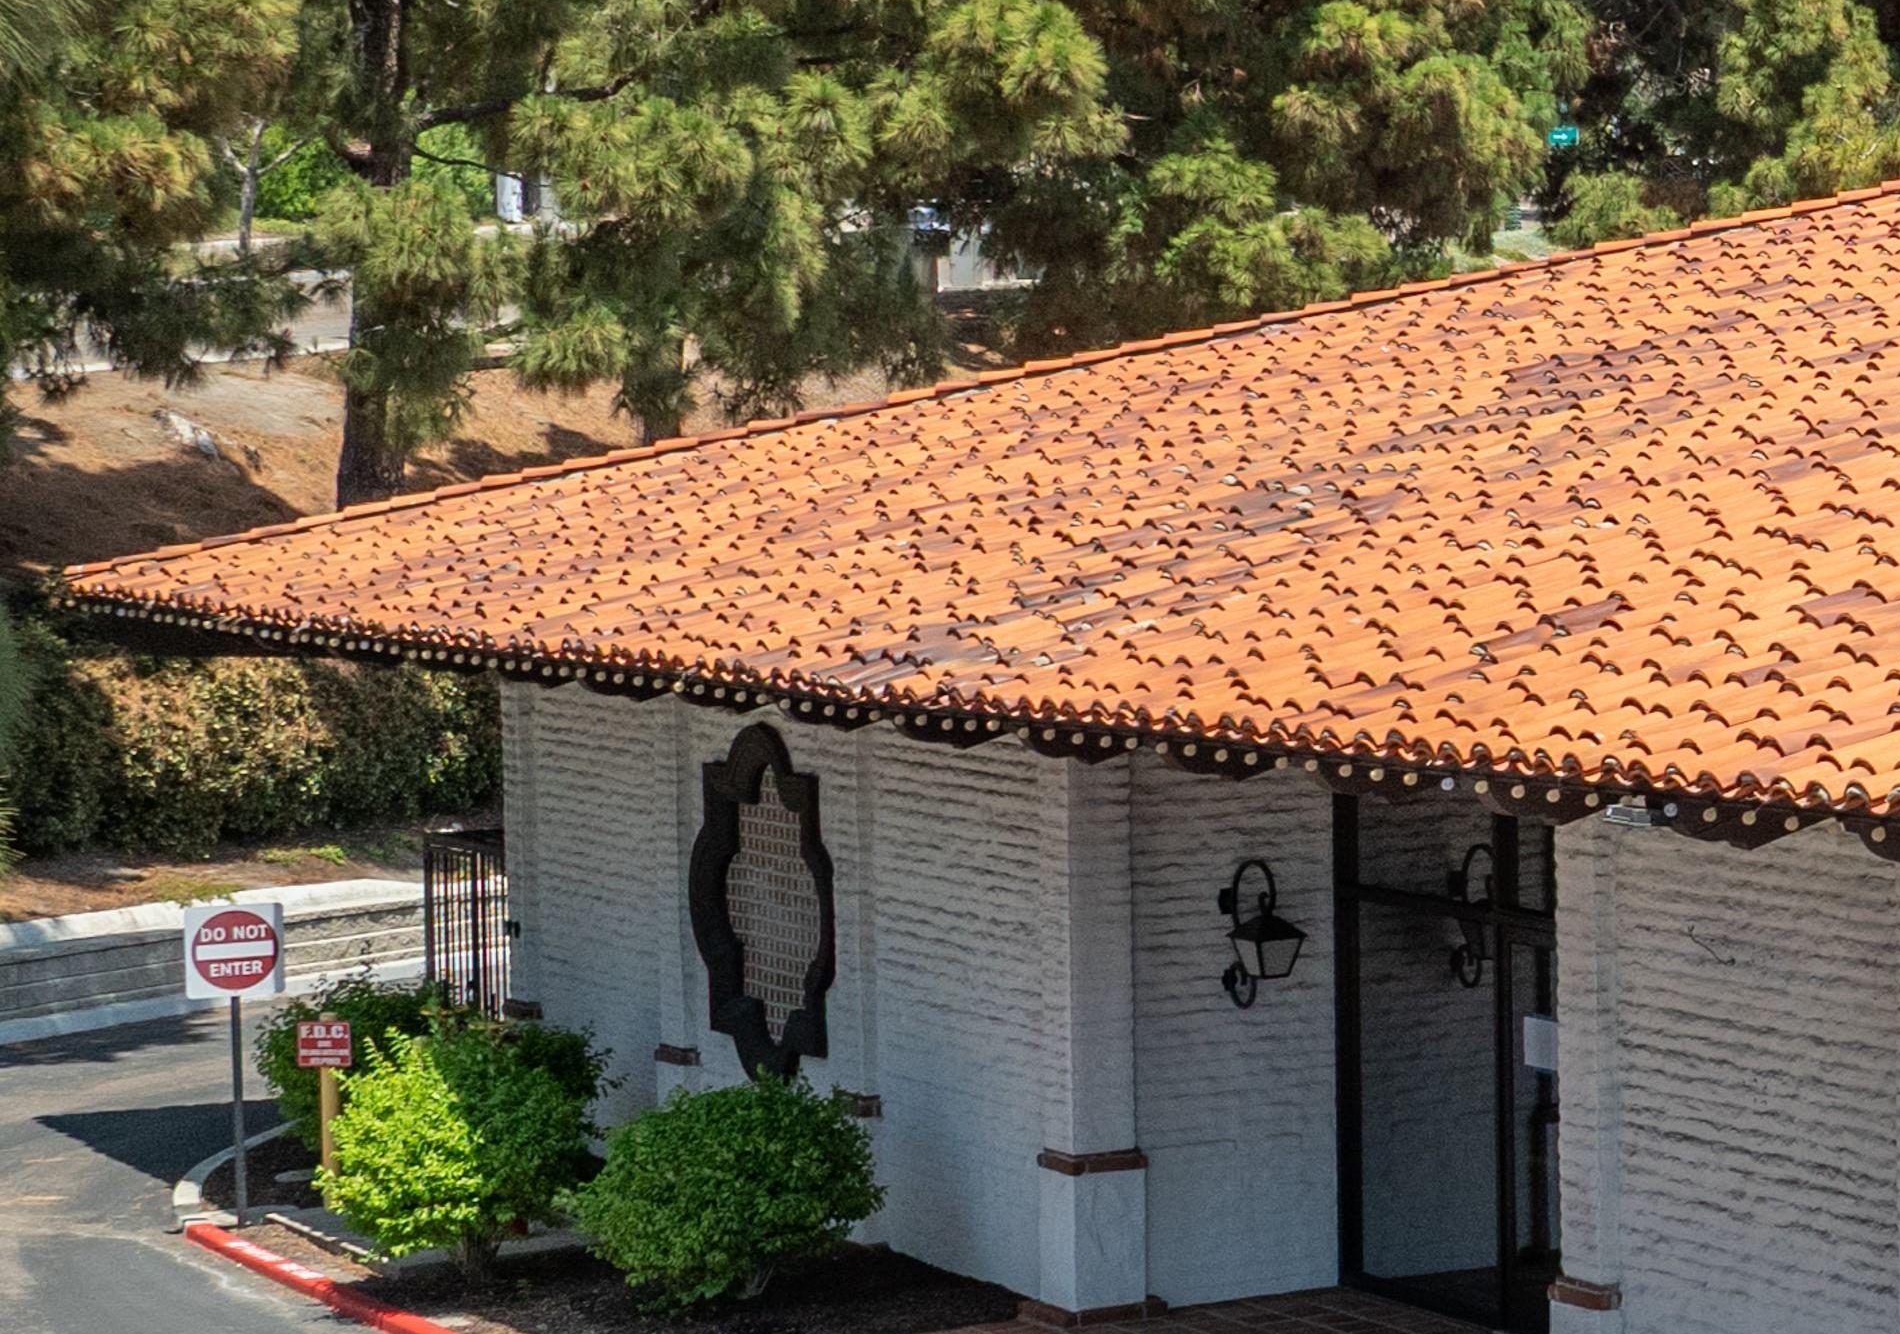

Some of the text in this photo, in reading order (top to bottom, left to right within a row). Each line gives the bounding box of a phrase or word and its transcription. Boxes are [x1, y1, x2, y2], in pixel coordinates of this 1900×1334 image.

[200, 924, 268, 943] DO NOT
[209, 960, 264, 978] ENTER
